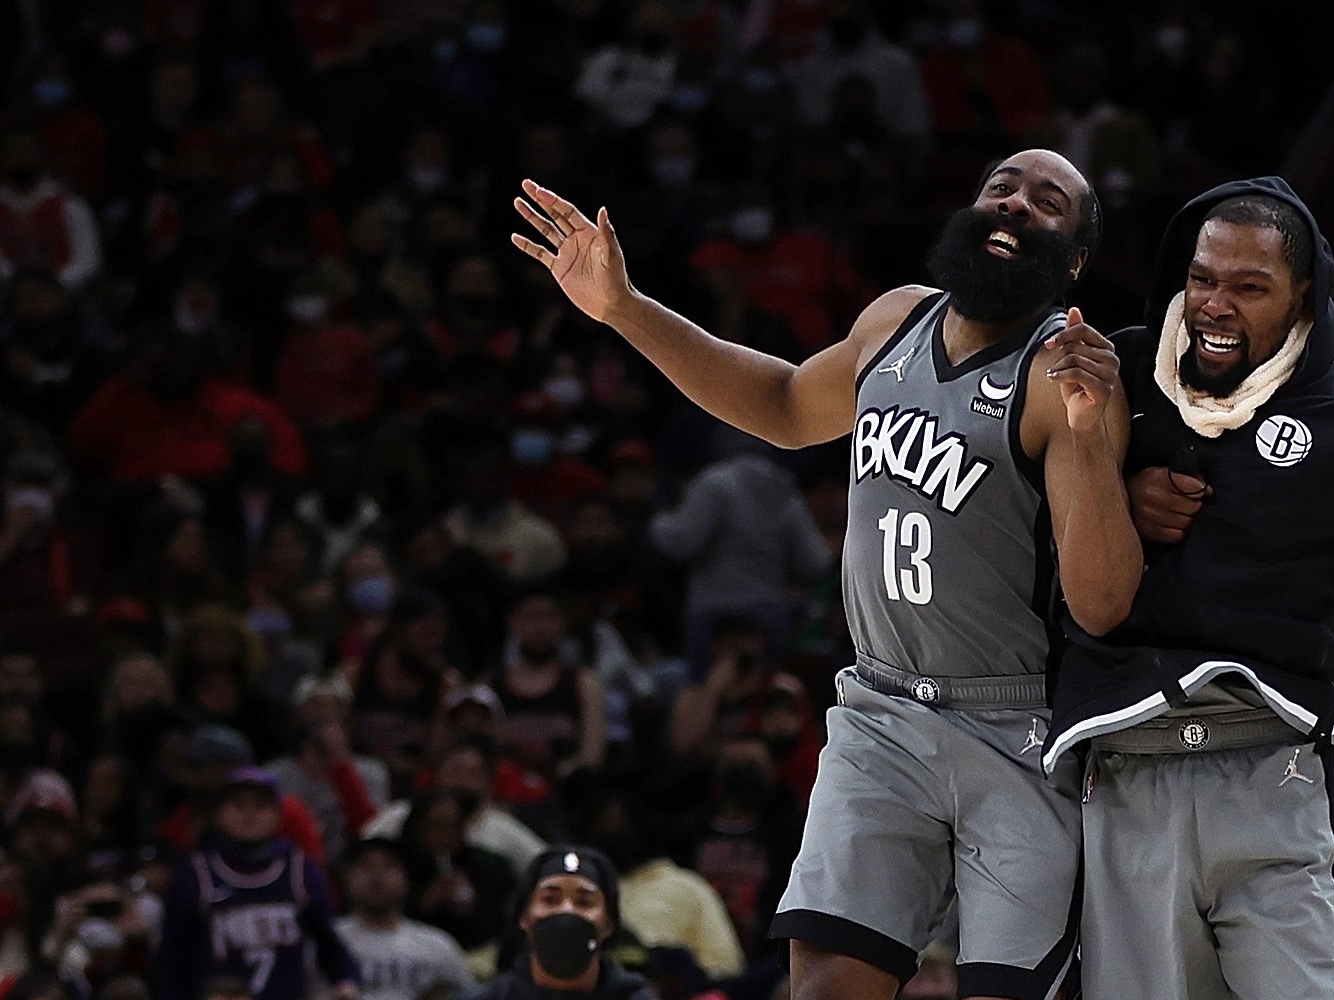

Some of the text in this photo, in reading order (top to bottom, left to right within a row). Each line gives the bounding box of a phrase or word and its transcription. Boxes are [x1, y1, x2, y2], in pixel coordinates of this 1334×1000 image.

[972, 400, 1004, 419] Webull
[855, 406, 991, 514] BKLYN
[1270, 421, 1297, 459] B
[878, 508, 933, 605] 13
[243, 950, 276, 996] 7
